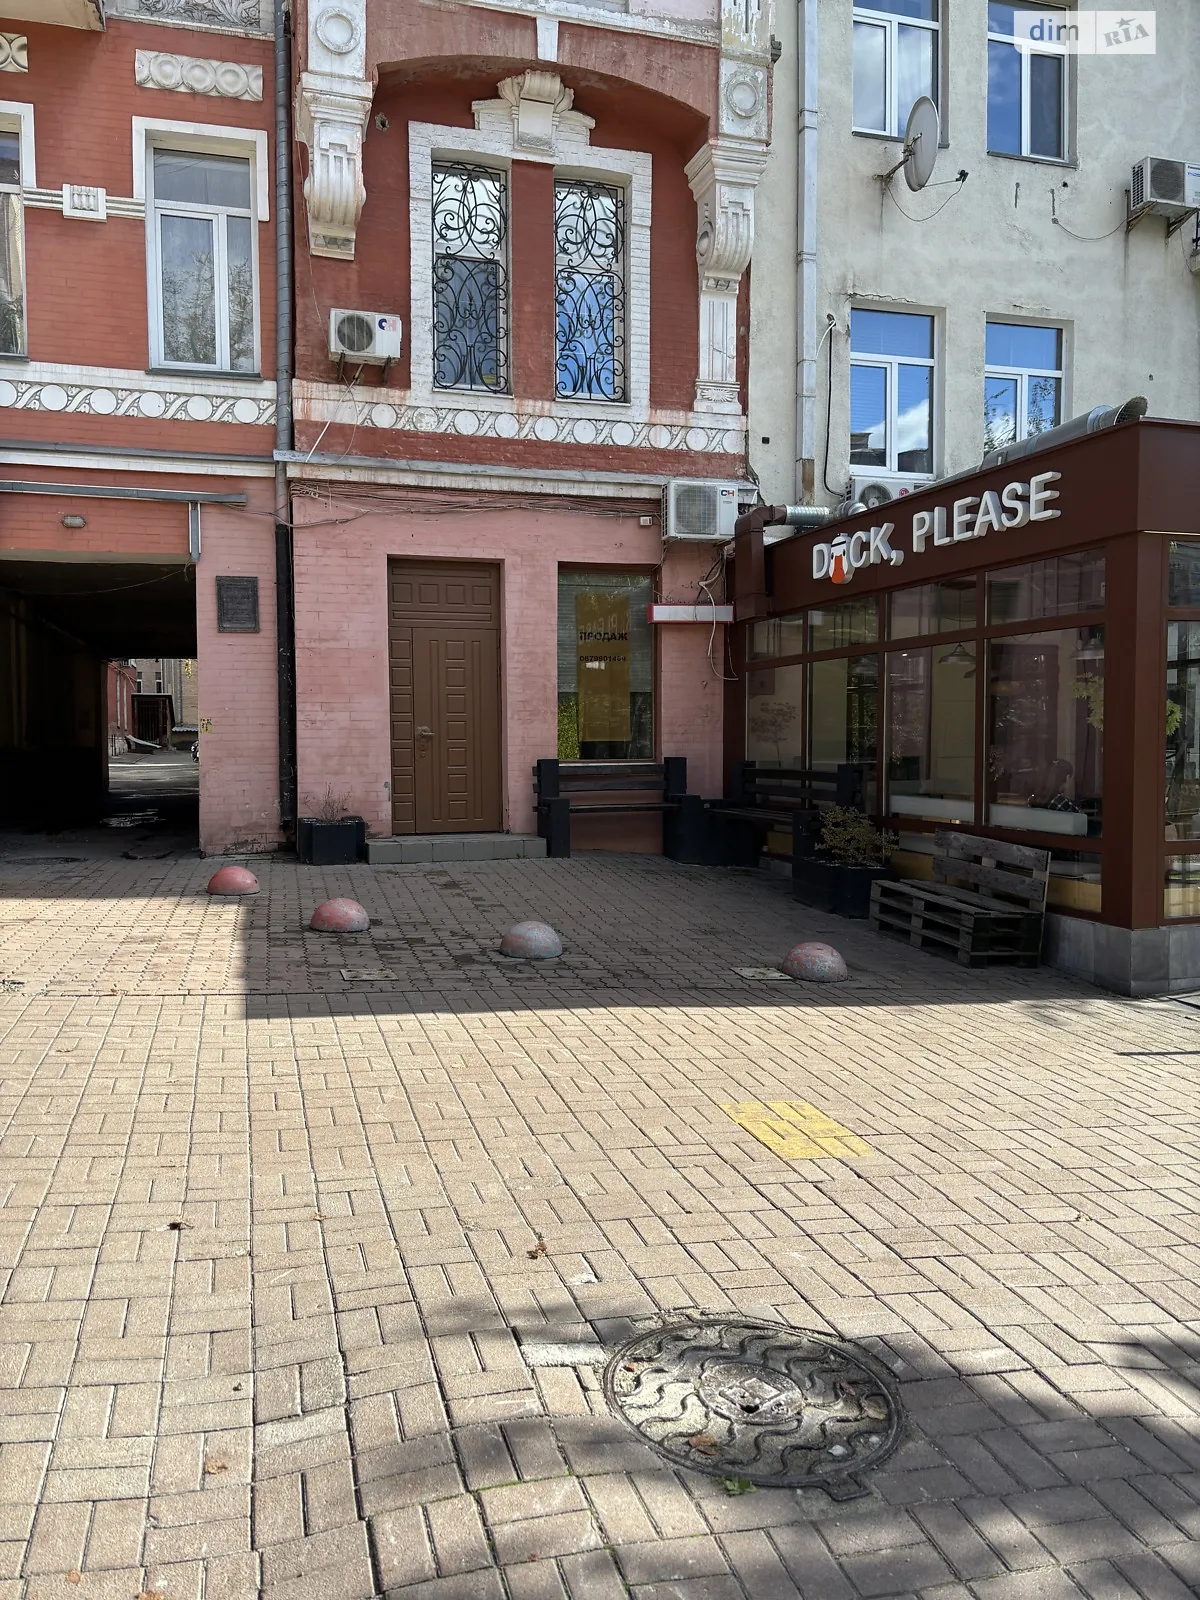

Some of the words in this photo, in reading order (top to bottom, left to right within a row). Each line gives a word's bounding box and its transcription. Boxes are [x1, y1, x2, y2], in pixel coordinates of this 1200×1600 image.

[812, 523, 904, 584] DCK,
[913, 472, 1061, 553] PLEASE
[580, 632, 628, 642] ПРОДАЖ
